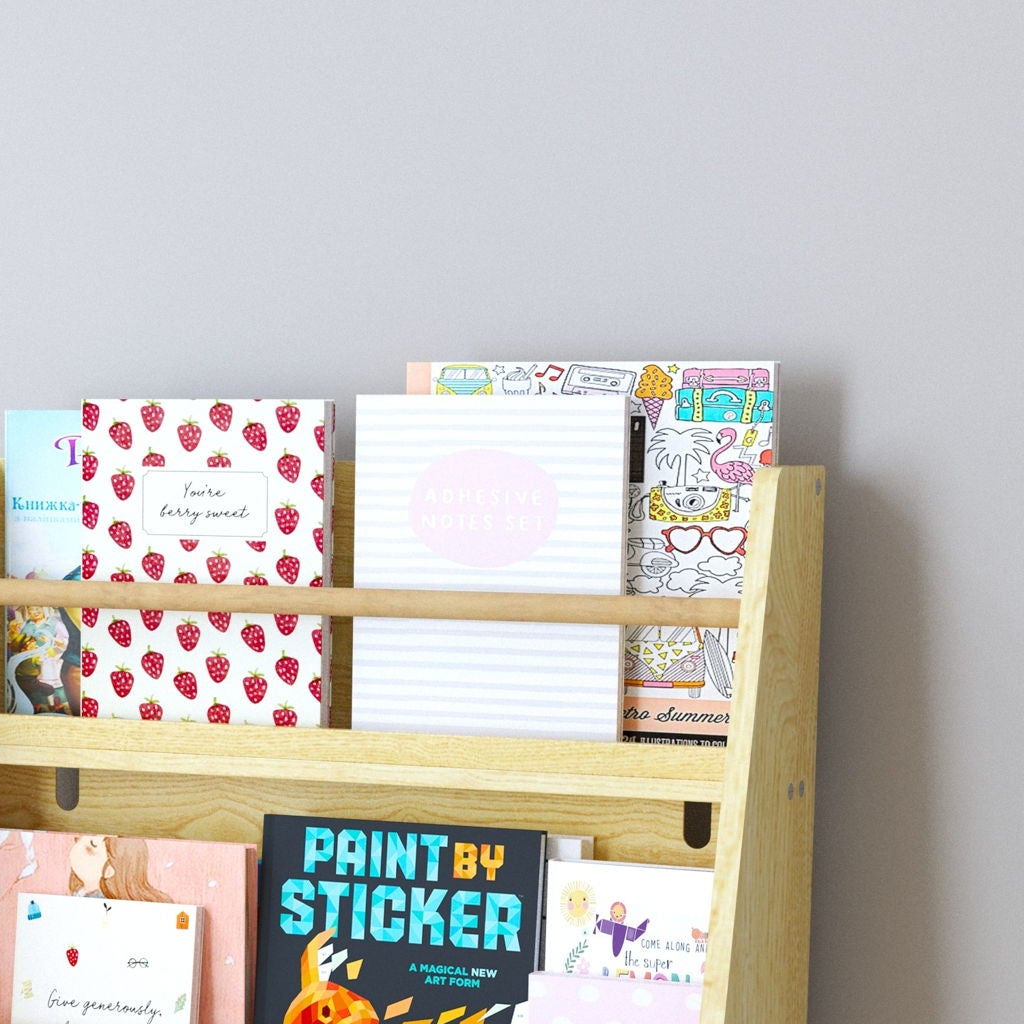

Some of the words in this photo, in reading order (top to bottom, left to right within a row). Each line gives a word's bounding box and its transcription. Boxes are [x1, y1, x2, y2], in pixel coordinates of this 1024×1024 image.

[183, 481, 226, 499] You're
[424, 488, 545, 505] ADHESIVE
[159, 503, 203, 525] berry
[205, 504, 250, 519] sweet
[421, 514, 494, 531] NOTES
[505, 515, 546, 531] SET
[654, 706, 730, 724] Summer
[304, 826, 449, 882] PAINT
[453, 841, 505, 881] BY
[279, 878, 522, 952] STICKER
[641, 938, 661, 950] COME
[666, 941, 691, 953] ALONG
[408, 962, 418, 972] A
[419, 963, 469, 977] MAGICAL
[471, 967, 498, 979] NEW
[624, 950, 640, 967] the
[643, 958, 674, 973] super
[424, 976, 447, 986] ART
[449, 977, 481, 989] FORM
[47, 988, 81, 1009] Give
